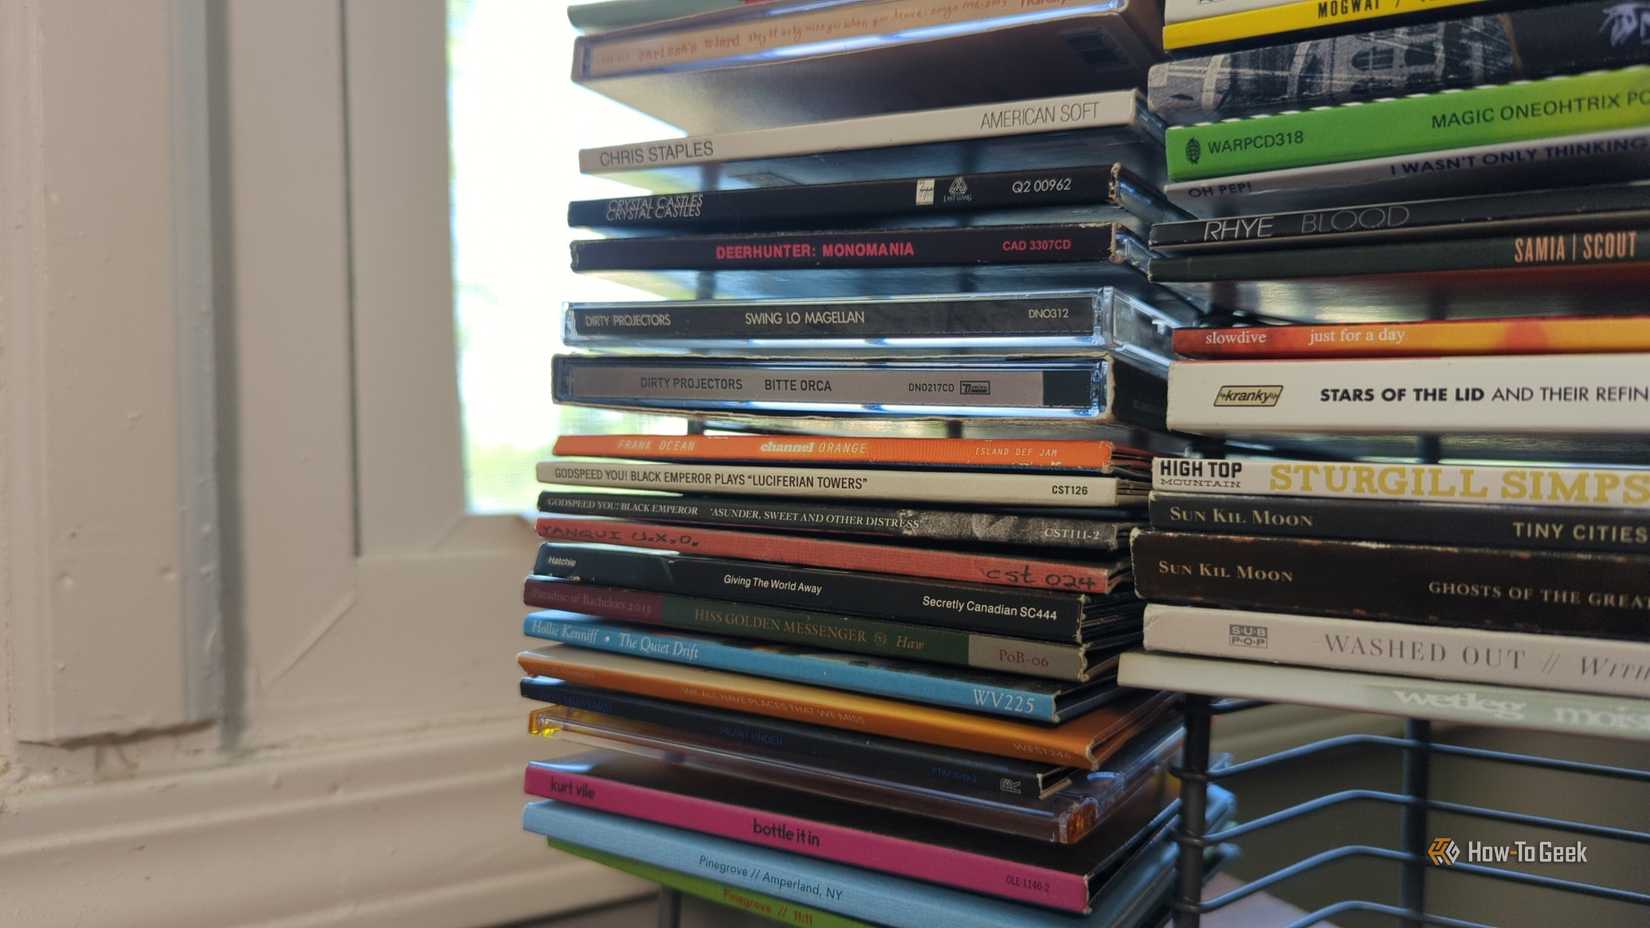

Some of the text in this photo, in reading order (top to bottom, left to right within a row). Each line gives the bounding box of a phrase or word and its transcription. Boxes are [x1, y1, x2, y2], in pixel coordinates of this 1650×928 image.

[1318, 0, 1381, 19] MOGWAI
[980, 102, 1099, 130] AMERICAN SOFT
[1431, 108, 1495, 129] MAGIC
[1499, 93, 1621, 121] ONEOHTRIX
[1208, 130, 1305, 155] WARPCD318
[600, 140, 714, 167] CHRIS STAPLES
[1401, 157, 1476, 174] WASN'T
[1482, 149, 1537, 165] ONLY
[1546, 136, 1650, 158] THINKING
[1011, 178, 1072, 194] Q2 00962
[1188, 186, 1214, 199] OH
[607, 193, 703, 211] CRYSTAL CASTLES
[605, 204, 702, 222] CRYSTAL CASTLES
[1203, 206, 1410, 241] RHYE BLOOD
[716, 241, 914, 260] DEERHUNTER: MONOMANIA
[1002, 238, 1072, 251] CAD 3307CD
[1513, 231, 1638, 264] SAMIA SCOUT
[584, 313, 672, 327] DIRTY PROJECTORS
[745, 310, 865, 326] SWING LO MAGELLAN
[1206, 327, 1405, 346] slowdive just for a day
[640, 376, 743, 391] DIRTY PROJECTORS
[764, 378, 832, 392] BITTE ORCA
[1225, 389, 1270, 405] kranky
[1320, 388, 1374, 402] STARS
[1381, 388, 1406, 402] OF
[1413, 388, 1447, 402] THE
[1455, 387, 1485, 402] LID
[1491, 387, 1534, 401] AND
[1540, 386, 1589, 401] THEIR
[616, 439, 696, 452] FRANK OCEAN
[760, 441, 868, 454] channel ORANGE
[975, 447, 1009, 457] ISLAND
[555, 467, 604, 480] GODSPEED
[606, 469, 628, 481] YOU!
[631, 470, 662, 483] BLACK
[664, 471, 712, 485] EMPEROR
[714, 473, 745, 486] PLAYS
[1160, 459, 1242, 479] HIGH TOP
[1160, 478, 1242, 489] MOUNTAIN
[1269, 463, 1489, 497] STURGILL
[1052, 485, 1088, 496] CST126
[547, 497, 595, 509] GODSPEED
[620, 502, 650, 513] BLACK
[652, 504, 698, 516] EMPEROR
[764, 510, 798, 521] SWEET
[801, 513, 824, 523] AND
[826, 514, 863, 526] OTHER
[1512, 522, 1648, 544] TINY CITIES
[548, 555, 576, 567] Hatchie
[723, 574, 822, 596] Giving The World Away
[1045, 574, 1095, 590] 024
[1508, 586, 1531, 600] OF
[1540, 588, 1580, 604] THE
[1588, 591, 1650, 610] GREA
[922, 595, 1057, 621] Secretly Canadian SC444
[694, 608, 866, 643] HISS GOLDEN MESSENGER
[1231, 625, 1266, 637] SUB
[531, 619, 699, 662] Hollie Kenniff The Quiet Drift
[999, 648, 1049, 668] PoB-06
[1324, 633, 1446, 662] WASHED
[1462, 646, 1525, 669] OUT
[973, 688, 1035, 713] WV225
[550, 776, 596, 799] kurt vile
[752, 818, 821, 847] bottle it in
[699, 855, 748, 877] Pinegrove
[762, 872, 822, 897] Amperland,
[826, 887, 843, 901] NY
[723, 887, 773, 913] Pinegrove
